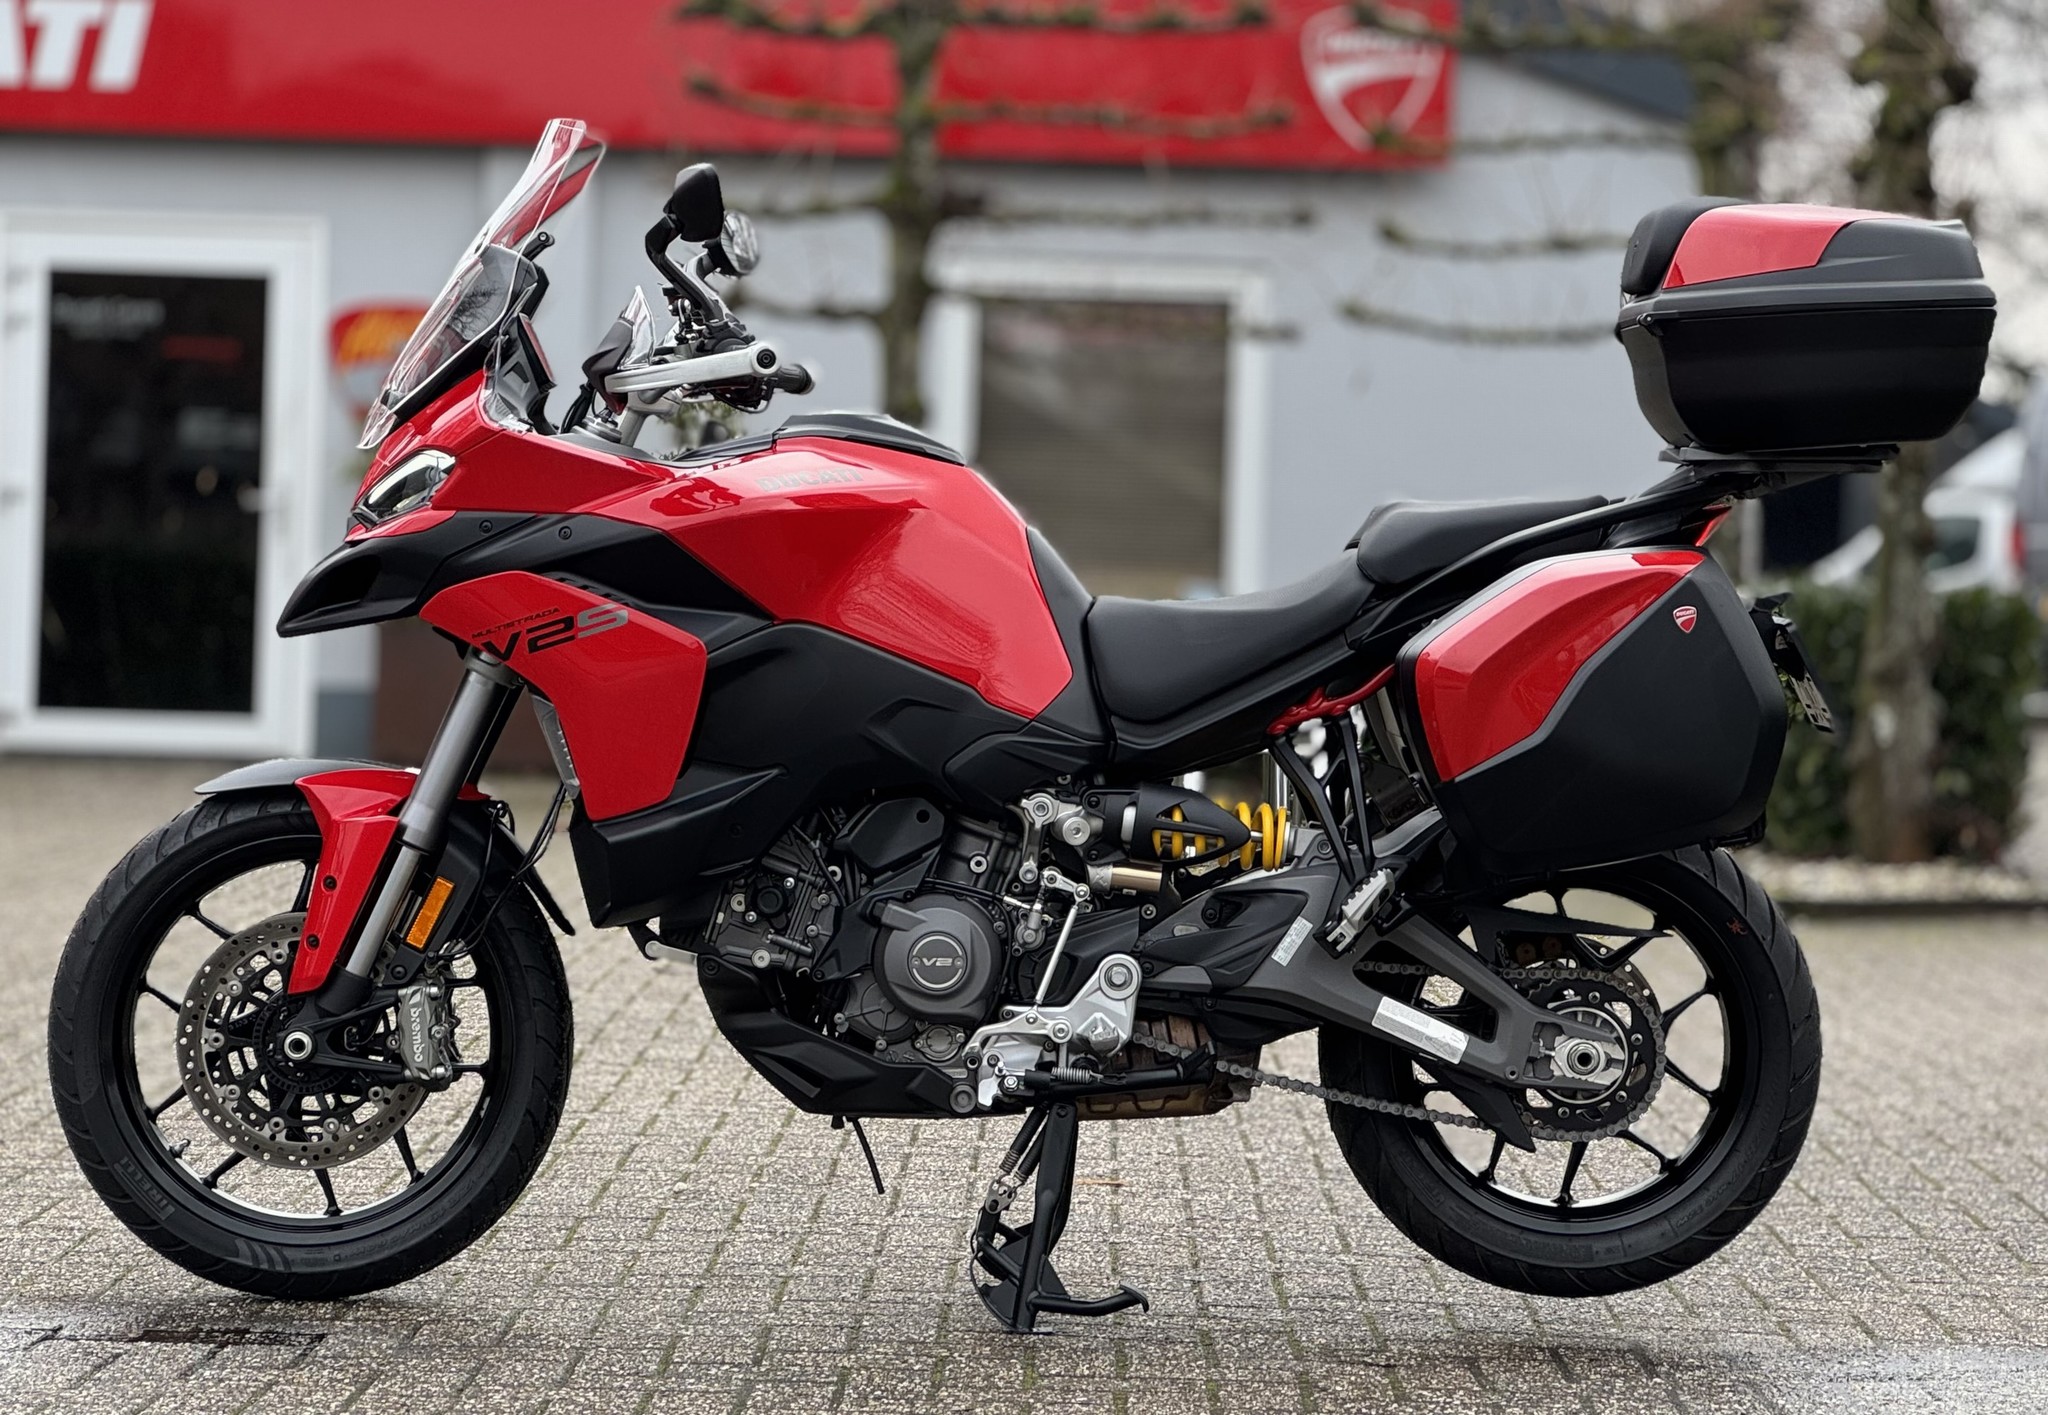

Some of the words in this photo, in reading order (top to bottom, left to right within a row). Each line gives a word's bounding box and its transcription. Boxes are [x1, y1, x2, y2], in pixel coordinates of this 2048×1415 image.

[757, 468, 863, 492] DUCATI
[471, 607, 560, 640] MULTISTRADA
[922, 957, 953, 967] V2
[410, 1007, 426, 1063] brembo
[114, 1155, 176, 1221] PIRELLI
